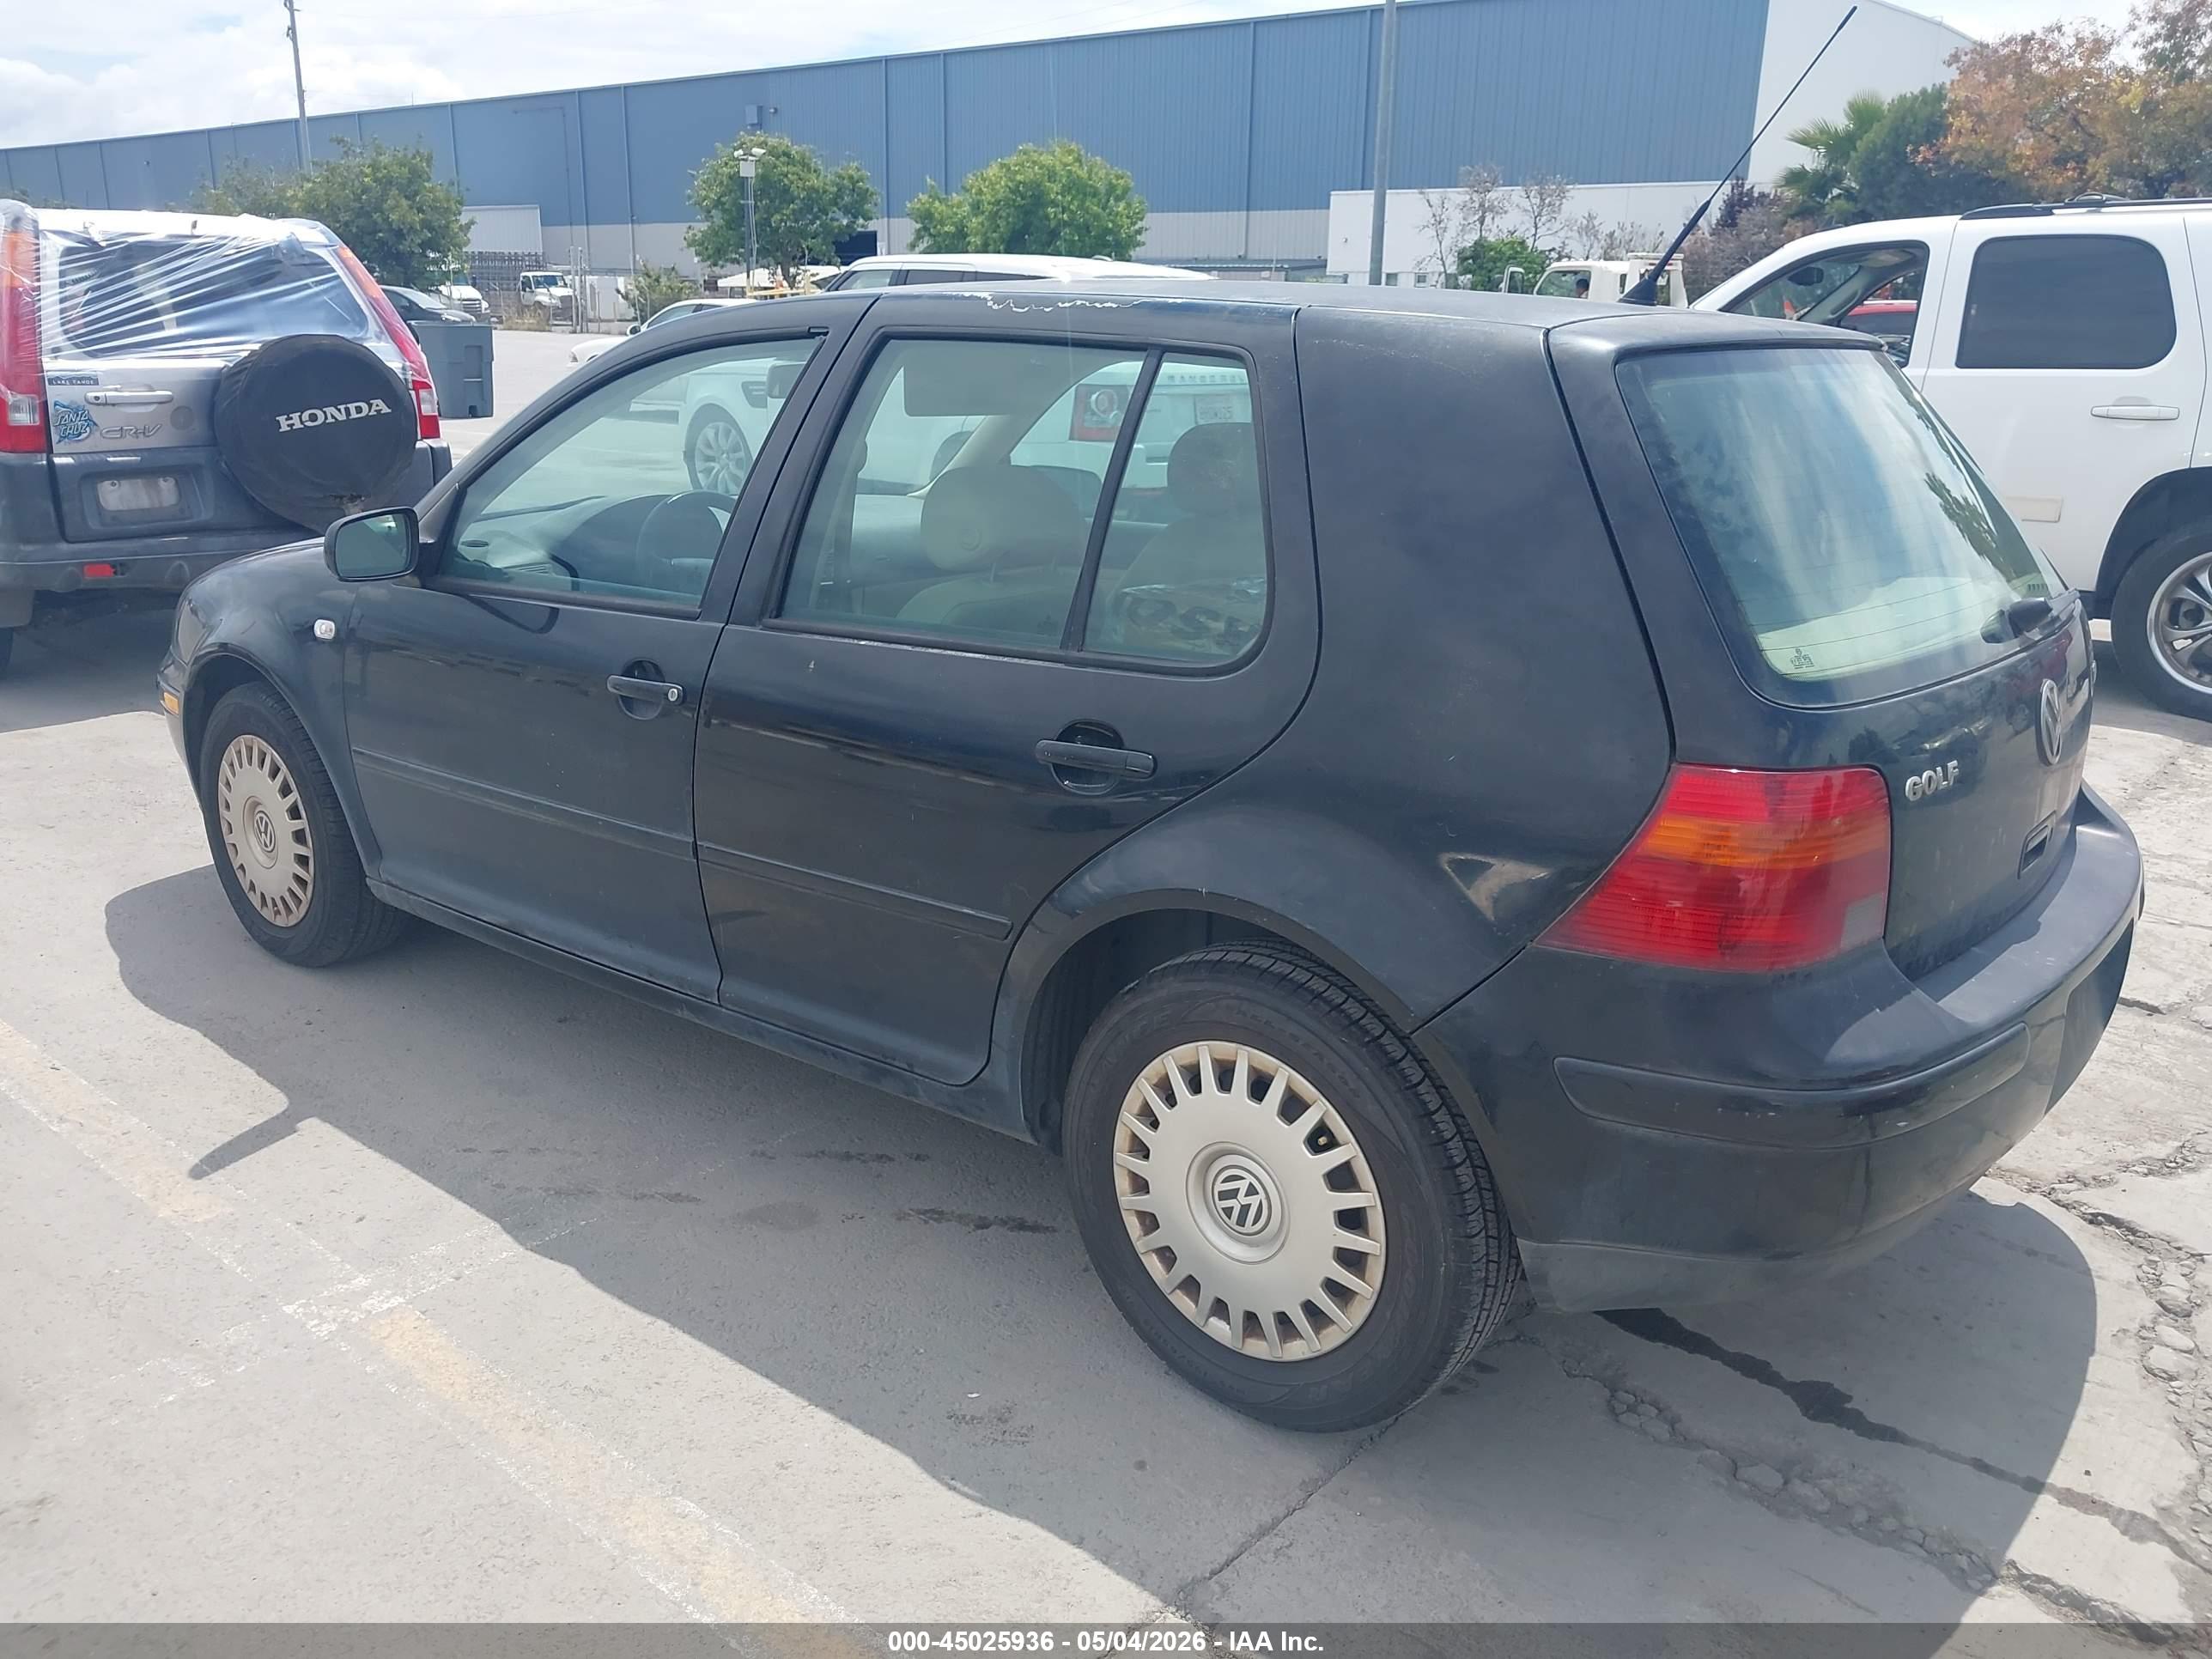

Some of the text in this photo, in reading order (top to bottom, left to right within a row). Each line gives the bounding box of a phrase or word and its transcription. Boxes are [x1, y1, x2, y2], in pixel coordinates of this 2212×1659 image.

[54, 410, 88, 426] SANTA
[276, 398, 392, 432] HONDA
[60, 422, 89, 437] CRUZ
[100, 424, 162, 439] CR-V
[1905, 760, 1960, 801] GOLF
